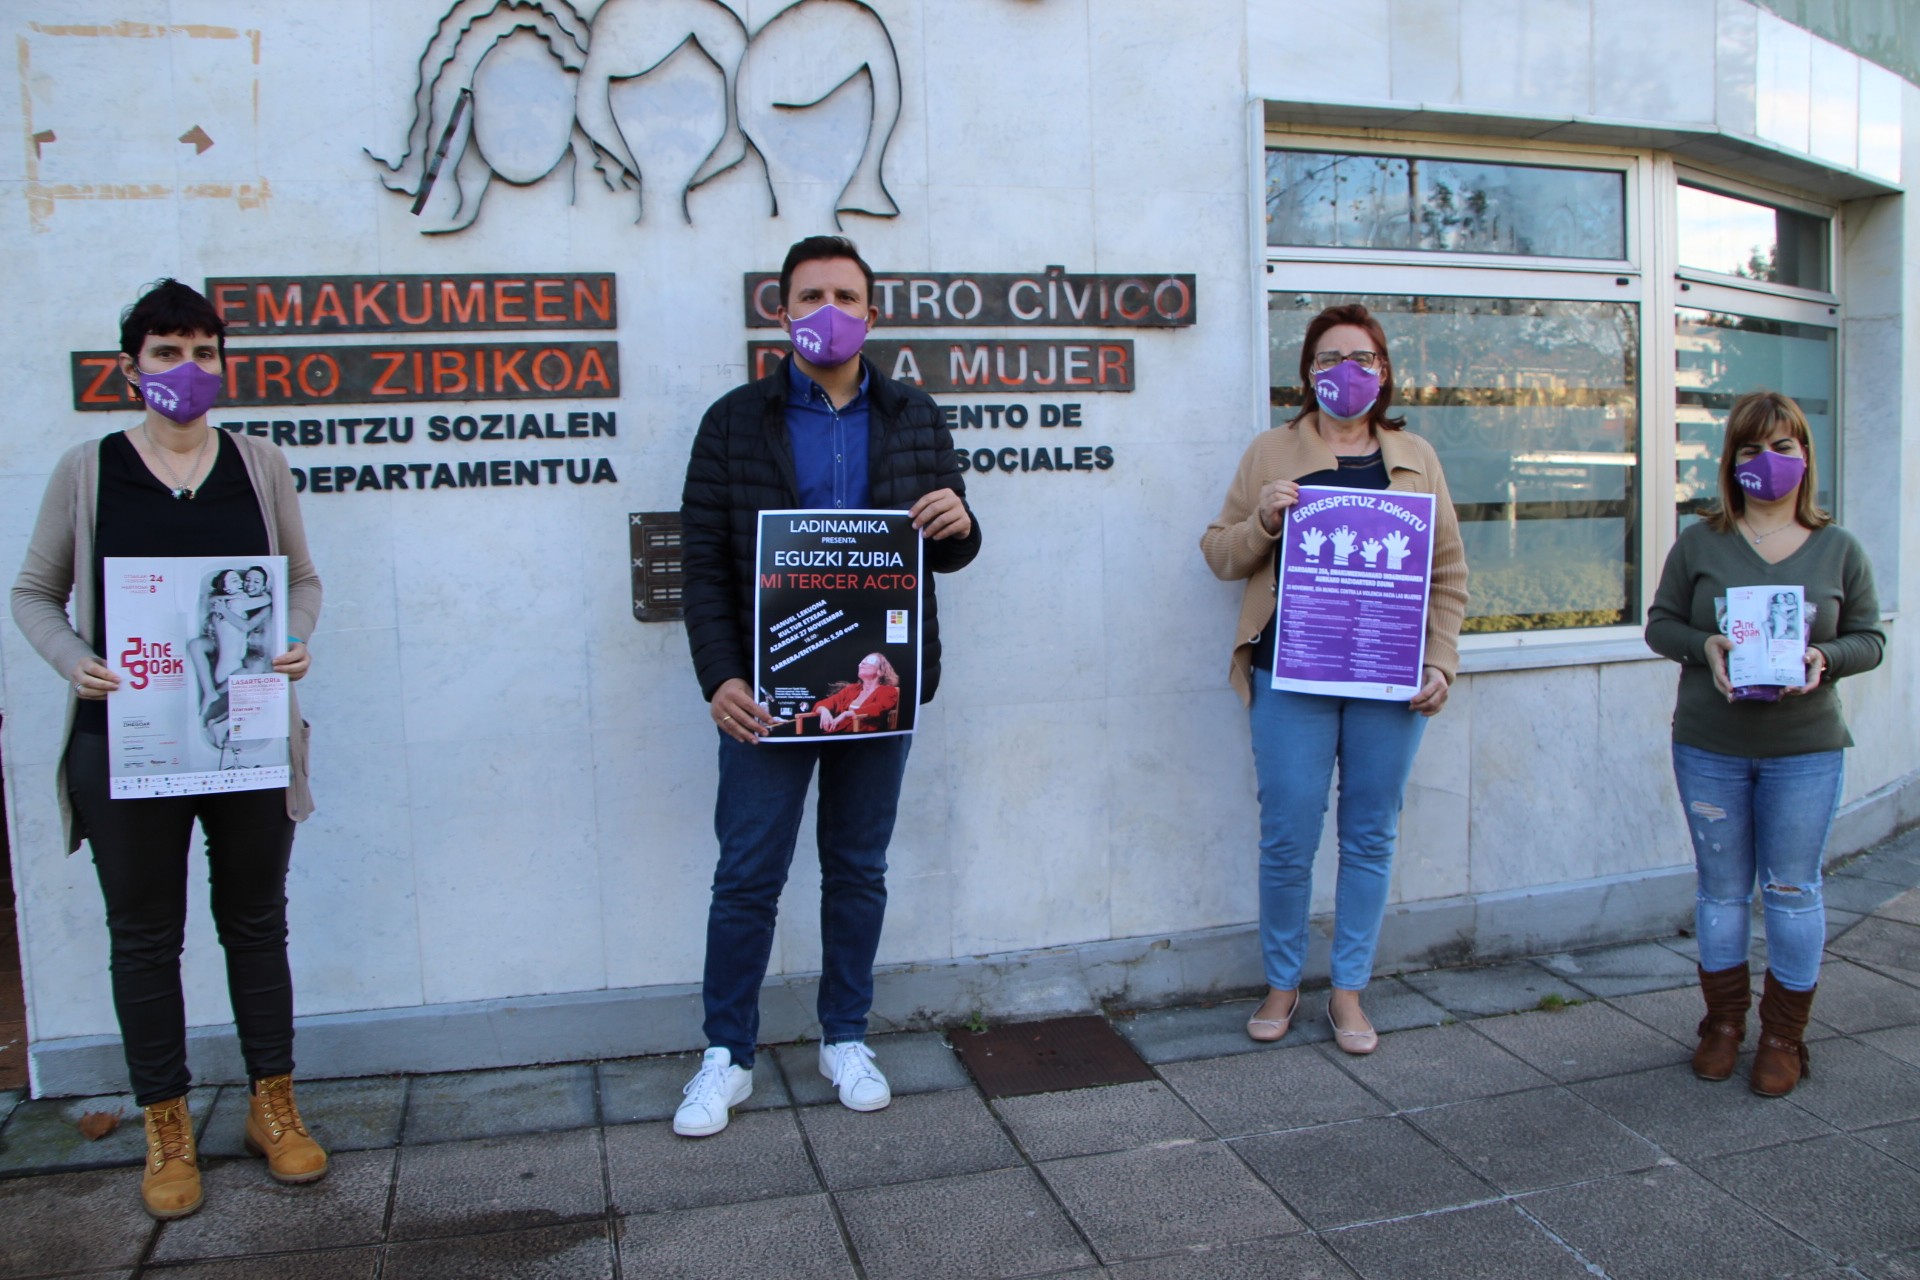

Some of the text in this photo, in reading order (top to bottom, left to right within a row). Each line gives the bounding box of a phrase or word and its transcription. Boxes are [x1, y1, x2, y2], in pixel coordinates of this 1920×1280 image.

[213, 279, 611, 328] EMAKUMEEN
[753, 269, 1191, 321] CTRO CÍVICO
[79, 352, 341, 404] ZTRO
[370, 347, 612, 396] ZIBIKOA
[949, 344, 1129, 386] MUJER
[427, 411, 617, 442] SOZIALEN
[1040, 403, 1082, 428] DE
[290, 457, 618, 494] DEPARTAMENTUA
[955, 445, 1114, 473] SOCIALES
[790, 520, 889, 534] LADINAMIKA
[1291, 495, 1428, 533] ERRESPETUZ JOKATU
[774, 551, 904, 567] EGUZKI ZUBIA
[760, 573, 917, 590] MI TERCER ACTO
[769, 599, 827, 633] MANUEL LEKUONA
[769, 609, 844, 653] AZAROAK 27 NOVIEMBRE
[777, 609, 828, 638] KULTUR ETXEAN
[770, 622, 860, 673] SARRERA/ENTRADA: 5,50 euro
[231, 677, 281, 686] LASARTE-ORIA
